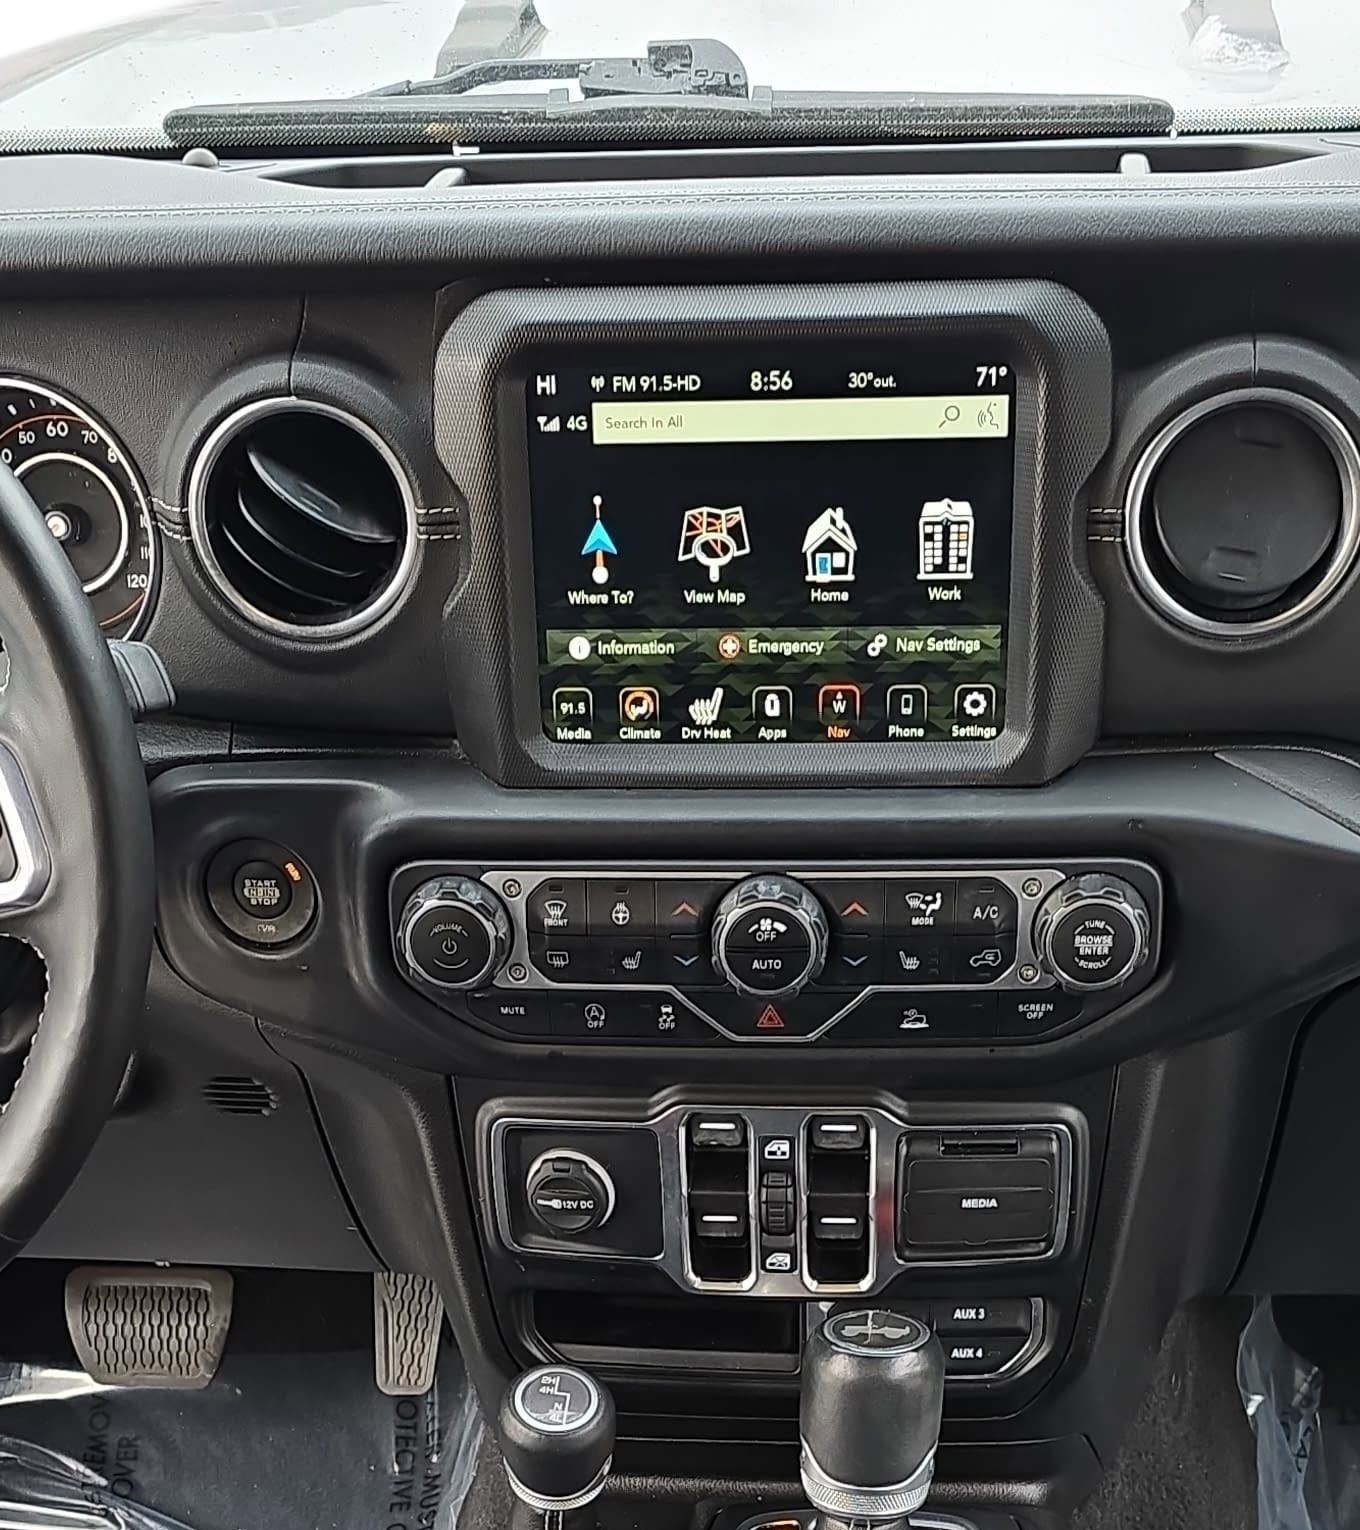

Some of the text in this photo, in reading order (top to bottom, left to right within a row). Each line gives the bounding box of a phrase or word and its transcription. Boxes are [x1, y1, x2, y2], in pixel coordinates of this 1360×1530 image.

[536, 375, 556, 396] HI
[613, 374, 702, 393] FM 91.5-HD
[750, 370, 793, 391] 8:56
[46, 420, 69, 438] 60
[566, 415, 588, 432] 4G
[605, 415, 683, 430] Search In All
[18, 430, 36, 444] 50
[81, 430, 98, 444] 70
[127, 574, 148, 589] 120
[568, 590, 635, 604] Where To?
[683, 589, 746, 605] View Map
[811, 588, 849, 602] Home
[928, 586, 962, 600] Work
[597, 640, 675, 655] Information
[748, 639, 824, 656] Emergency
[896, 636, 981, 654] Nav Settings
[559, 702, 586, 715] 91.5
[831, 700, 847, 714] W
[556, 727, 592, 740] Media
[619, 727, 662, 740] Climate
[681, 727, 732, 740] Drv Heat
[758, 726, 787, 741] Apps
[828, 726, 851, 738] Nav
[888, 725, 925, 737] Phone
[952, 724, 997, 740] Settings
[973, 904, 999, 920] A/C
[433, 922, 463, 933] VOLUME
[544, 918, 568, 928] FRONT
[911, 916, 934, 926] MODE
[1084, 919, 1106, 930] TUNE
[755, 931, 777, 943] OFF
[1074, 934, 1113, 945] BROWSE
[1079, 946, 1109, 956] ENTER
[752, 958, 782, 970] AUTO
[1078, 957, 1108, 970] SCROLL
[500, 1006, 526, 1015] MUTE
[1018, 1003, 1053, 1013] SCREEN
[1026, 1011, 1044, 1020] OFF
[587, 1021, 604, 1029] OFF
[658, 1022, 676, 1030] OFF
[562, 1200, 594, 1209] 12V DC
[961, 1198, 998, 1209] MEDIA
[953, 1308, 985, 1320] AUX 3
[951, 1348, 983, 1359] AUX 4
[539, 1386, 554, 1395] 4H
[84, 1393, 111, 1480] REMOV
[389, 1399, 419, 1514] OTECTIVE
[110, 1434, 141, 1499] OVER
